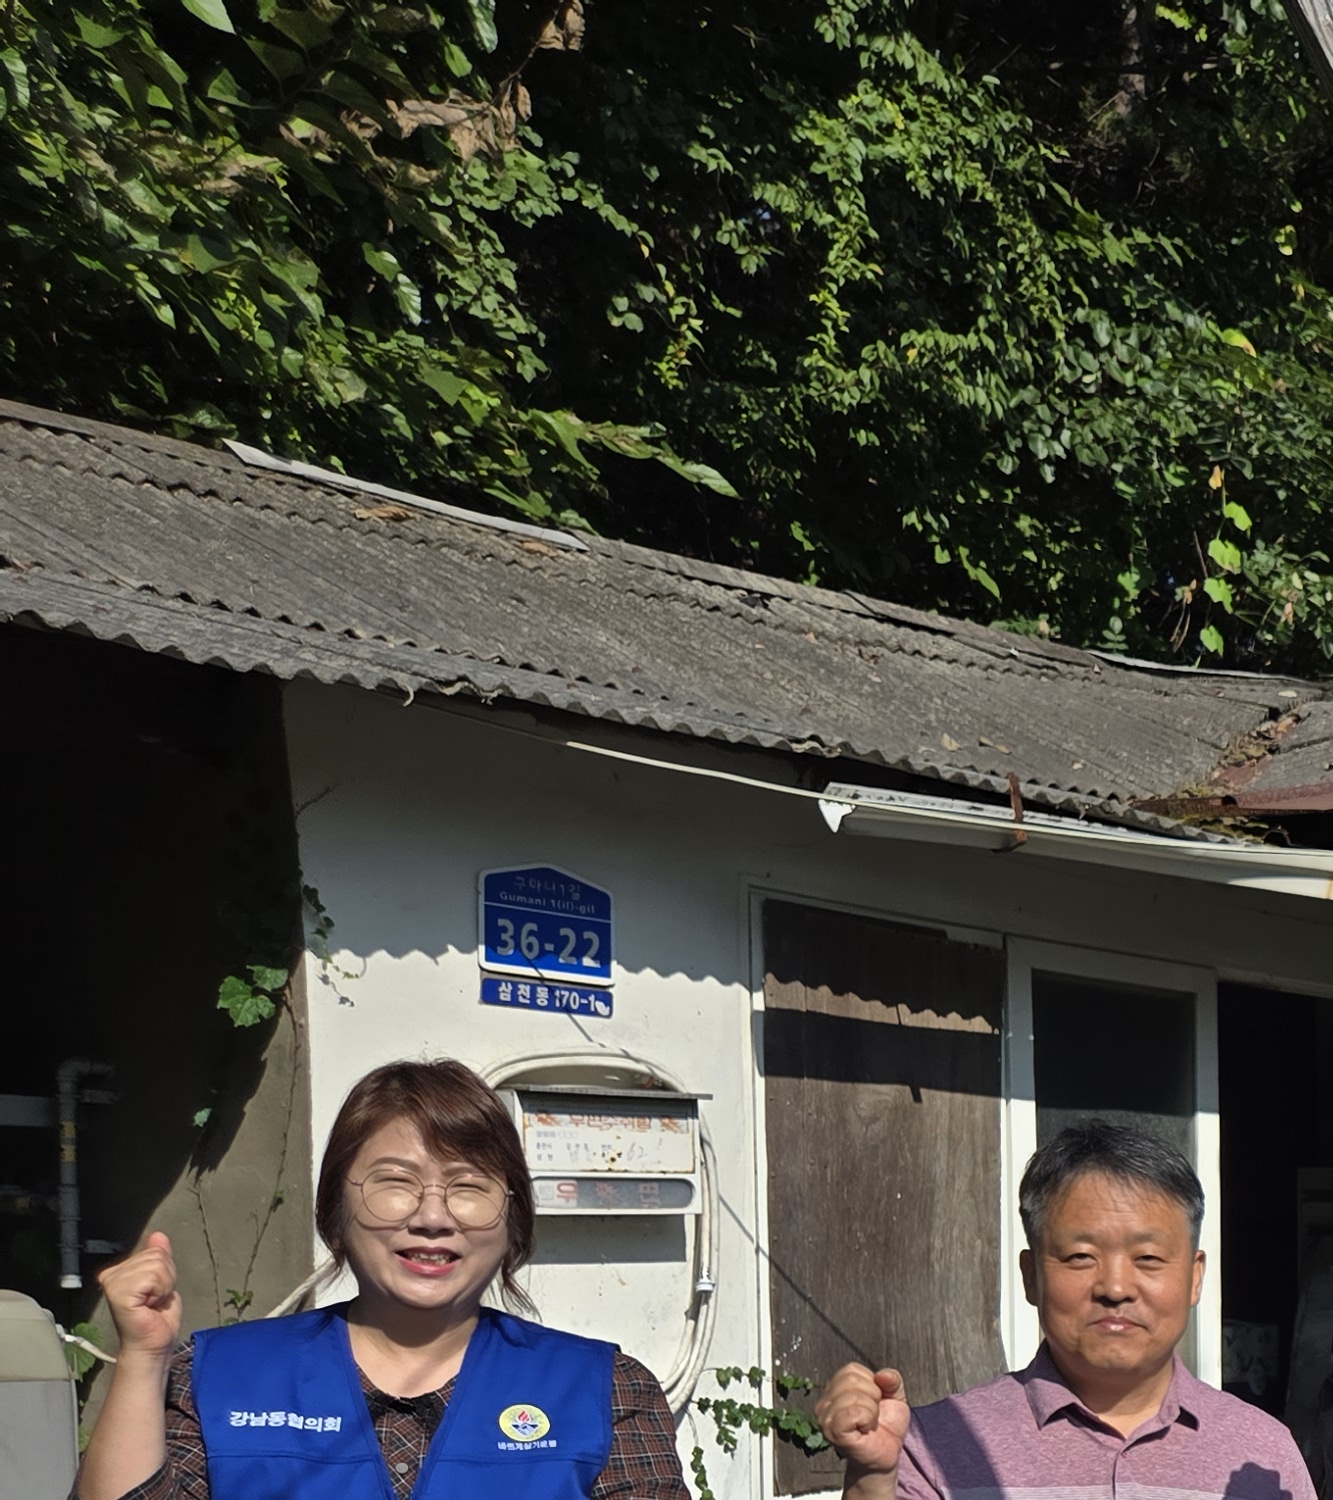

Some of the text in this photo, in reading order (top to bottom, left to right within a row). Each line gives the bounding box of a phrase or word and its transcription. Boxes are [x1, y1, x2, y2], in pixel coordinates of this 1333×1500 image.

[514, 876, 581, 900] 구마니1길
[499, 891, 596, 915] Gumani 1(il)-gil
[496, 918, 602, 968] 36-22
[498, 981, 549, 1007] 삼천동
[229, 1410, 342, 1433] 강남동협의회
